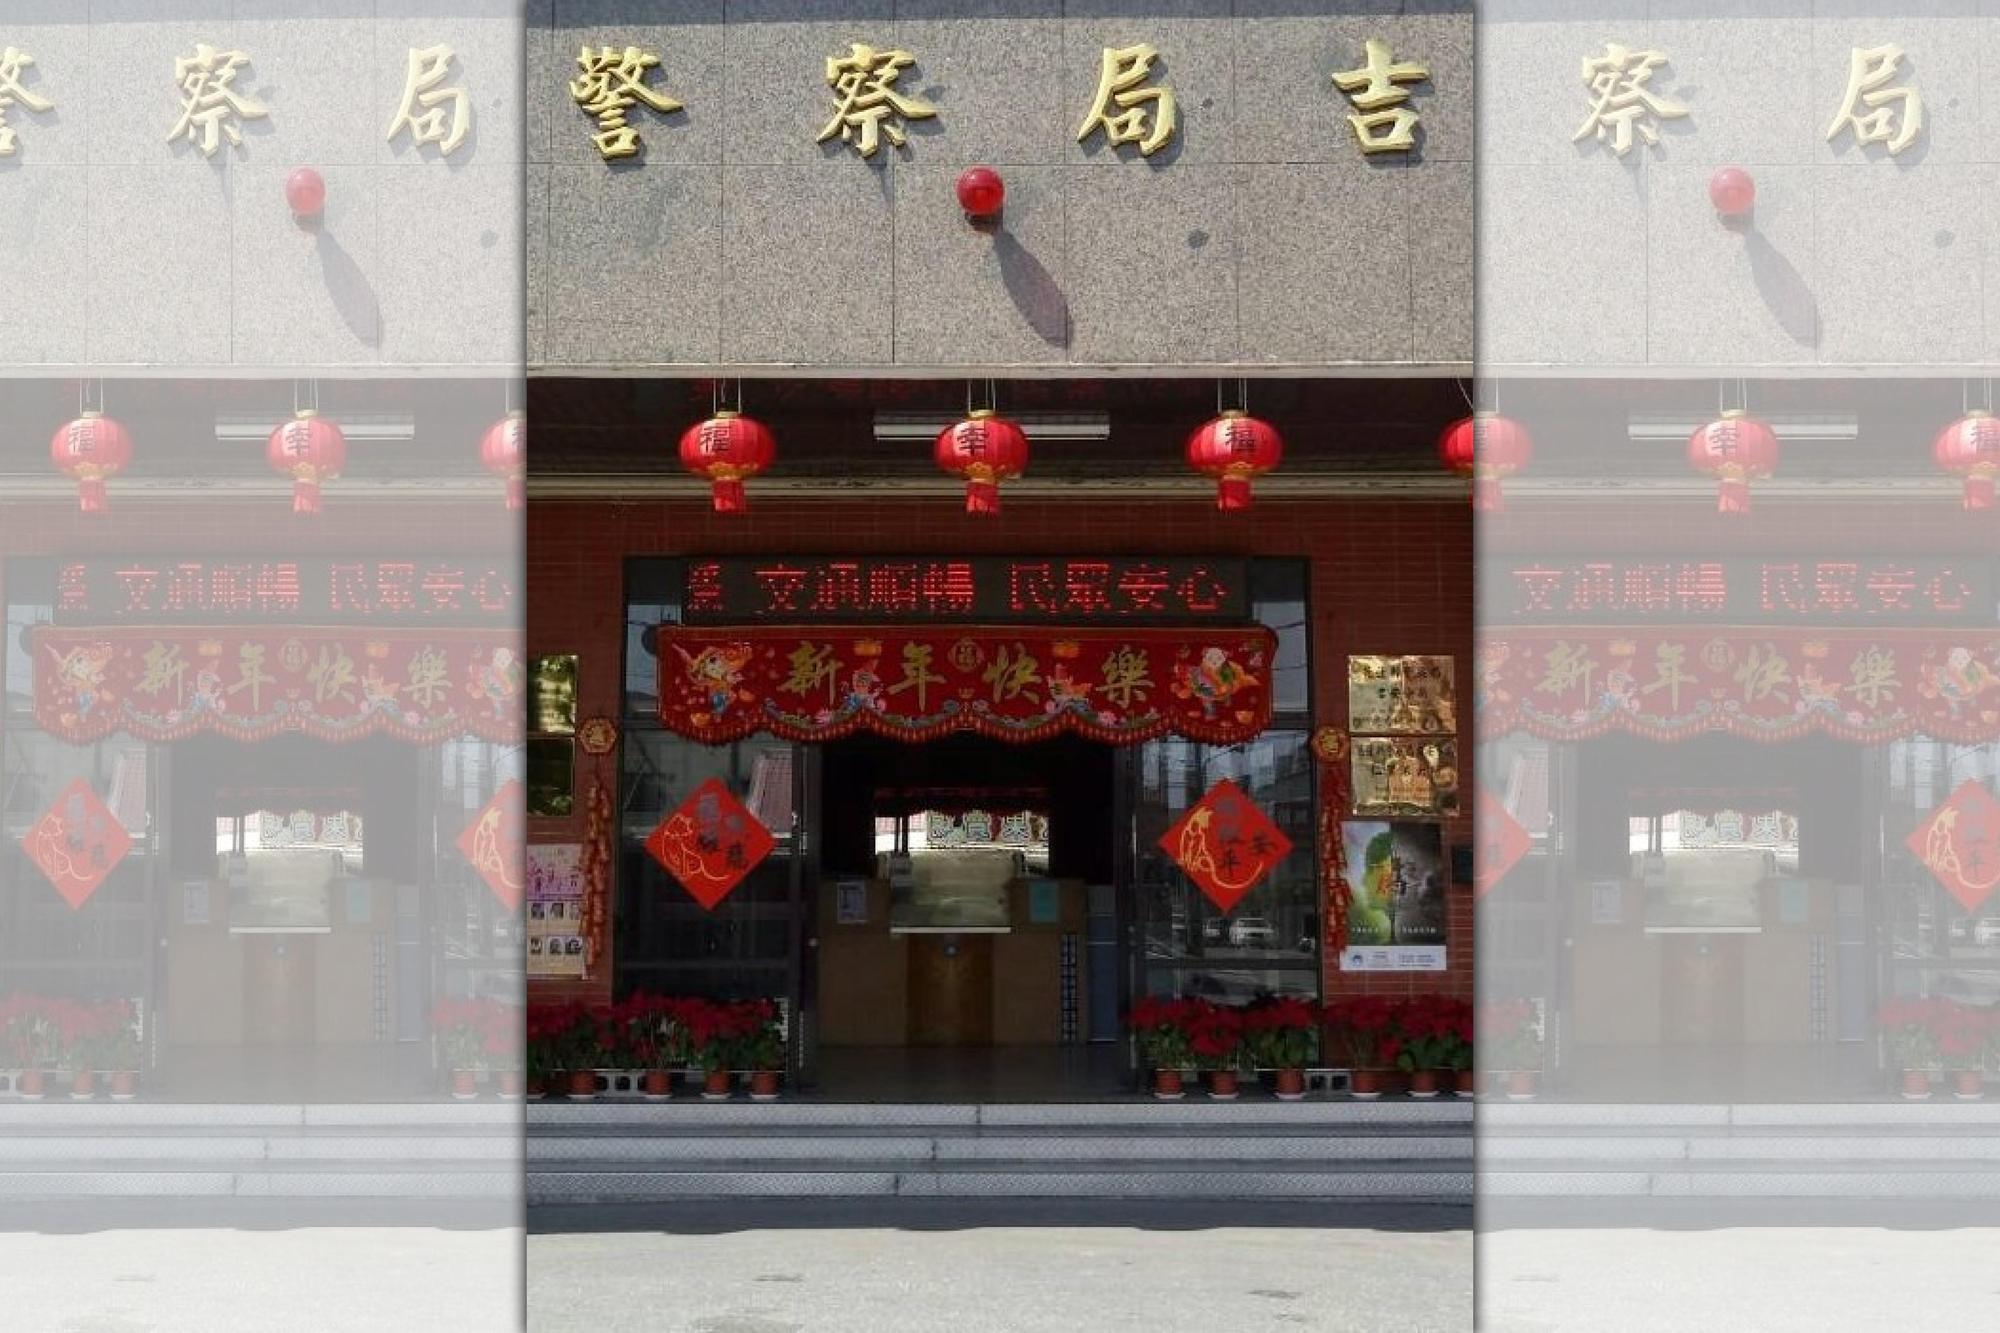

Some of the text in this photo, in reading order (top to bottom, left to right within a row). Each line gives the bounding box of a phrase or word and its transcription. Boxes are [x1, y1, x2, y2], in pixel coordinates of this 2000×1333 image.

[699, 423, 731, 453] 福
[1225, 424, 1256, 452] 福
[133, 640, 455, 711] 新年快樂
[776, 639, 1155, 712] 新年快樂
[1533, 639, 1902, 711] 新年快樂
